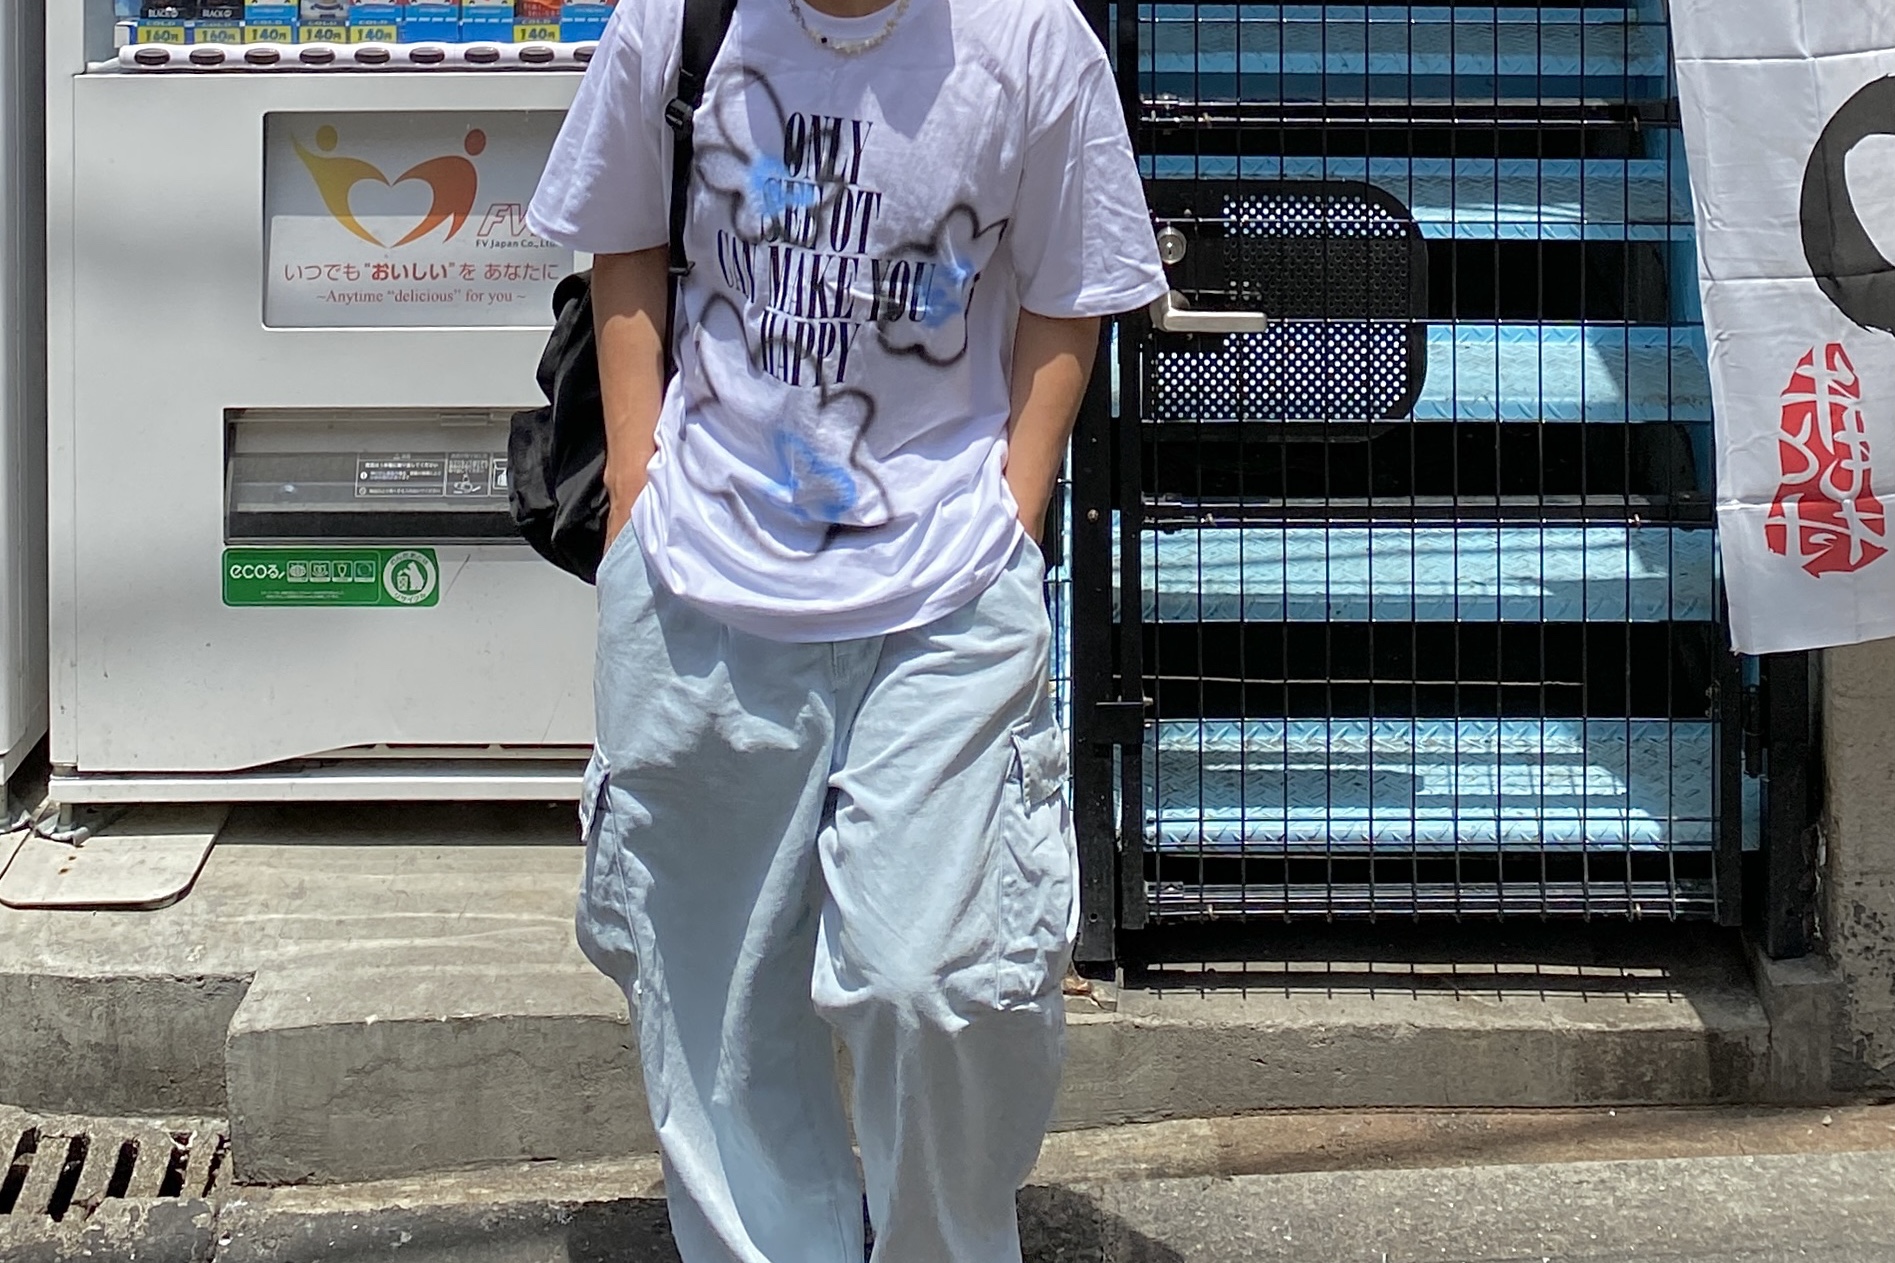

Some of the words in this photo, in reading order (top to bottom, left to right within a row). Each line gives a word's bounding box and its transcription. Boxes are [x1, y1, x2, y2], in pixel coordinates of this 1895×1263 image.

[784, 112, 873, 186] ONLY
[476, 202, 541, 238] FV
[490, 238, 519, 250] Japan
[484, 262, 560, 282] あなたに
[717, 229, 759, 305] CAN
[767, 244, 861, 320] MAKE
[869, 257, 939, 324] YOU
[465, 288, 485, 303] for
[487, 292, 513, 307] you
[760, 309, 863, 387] HAPPY
